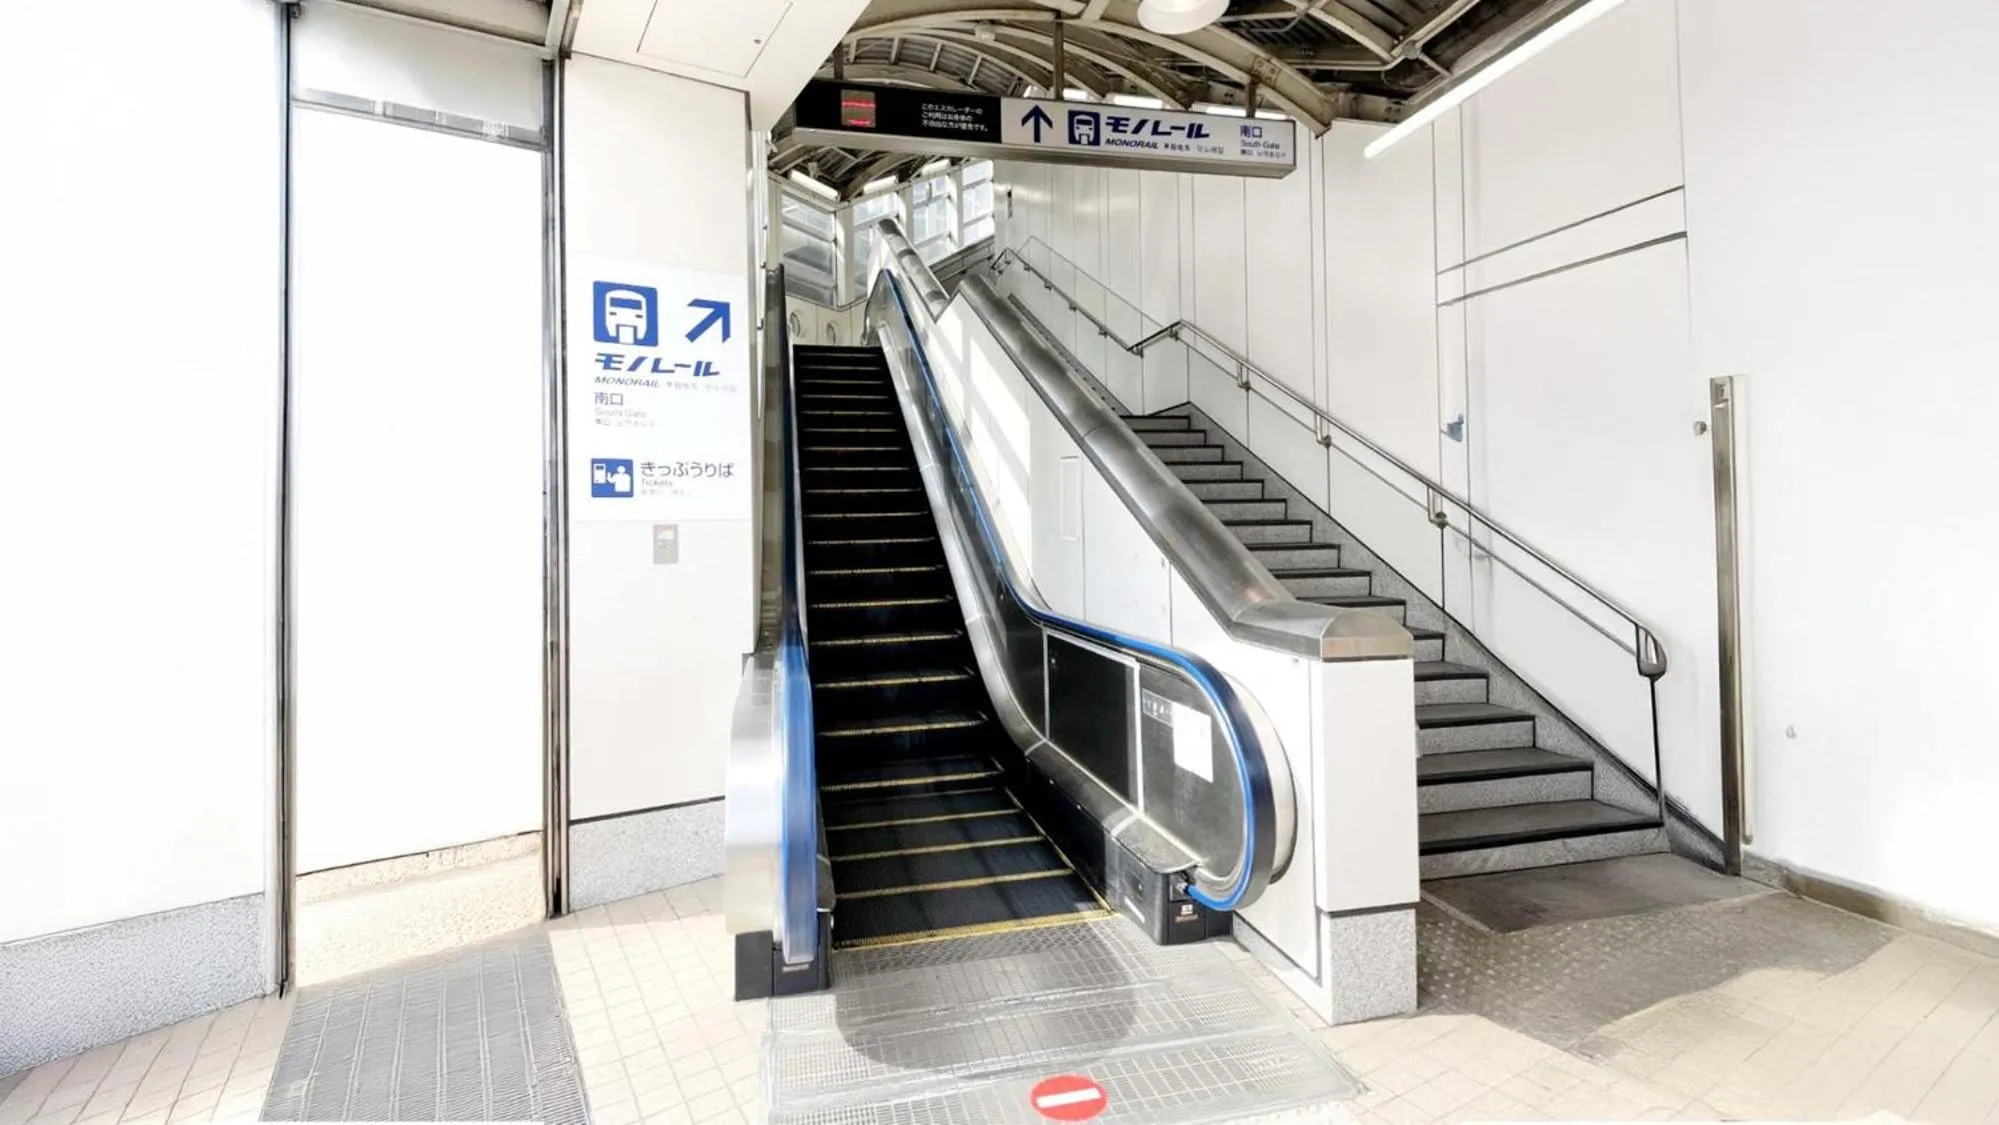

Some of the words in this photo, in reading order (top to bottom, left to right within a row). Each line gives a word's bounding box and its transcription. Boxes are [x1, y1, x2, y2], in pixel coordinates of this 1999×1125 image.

[1105, 116, 1210, 139] モノレール
[1240, 125, 1263, 138] 南口
[1105, 138, 1159, 149] MONORAIL
[1240, 140, 1261, 149] South
[1262, 141, 1280, 150] Gate
[594, 352, 720, 377] モノレール
[594, 376, 660, 388] MONORAIL
[594, 392, 624, 406] 南口
[640, 461, 734, 478] きっぷうりば
